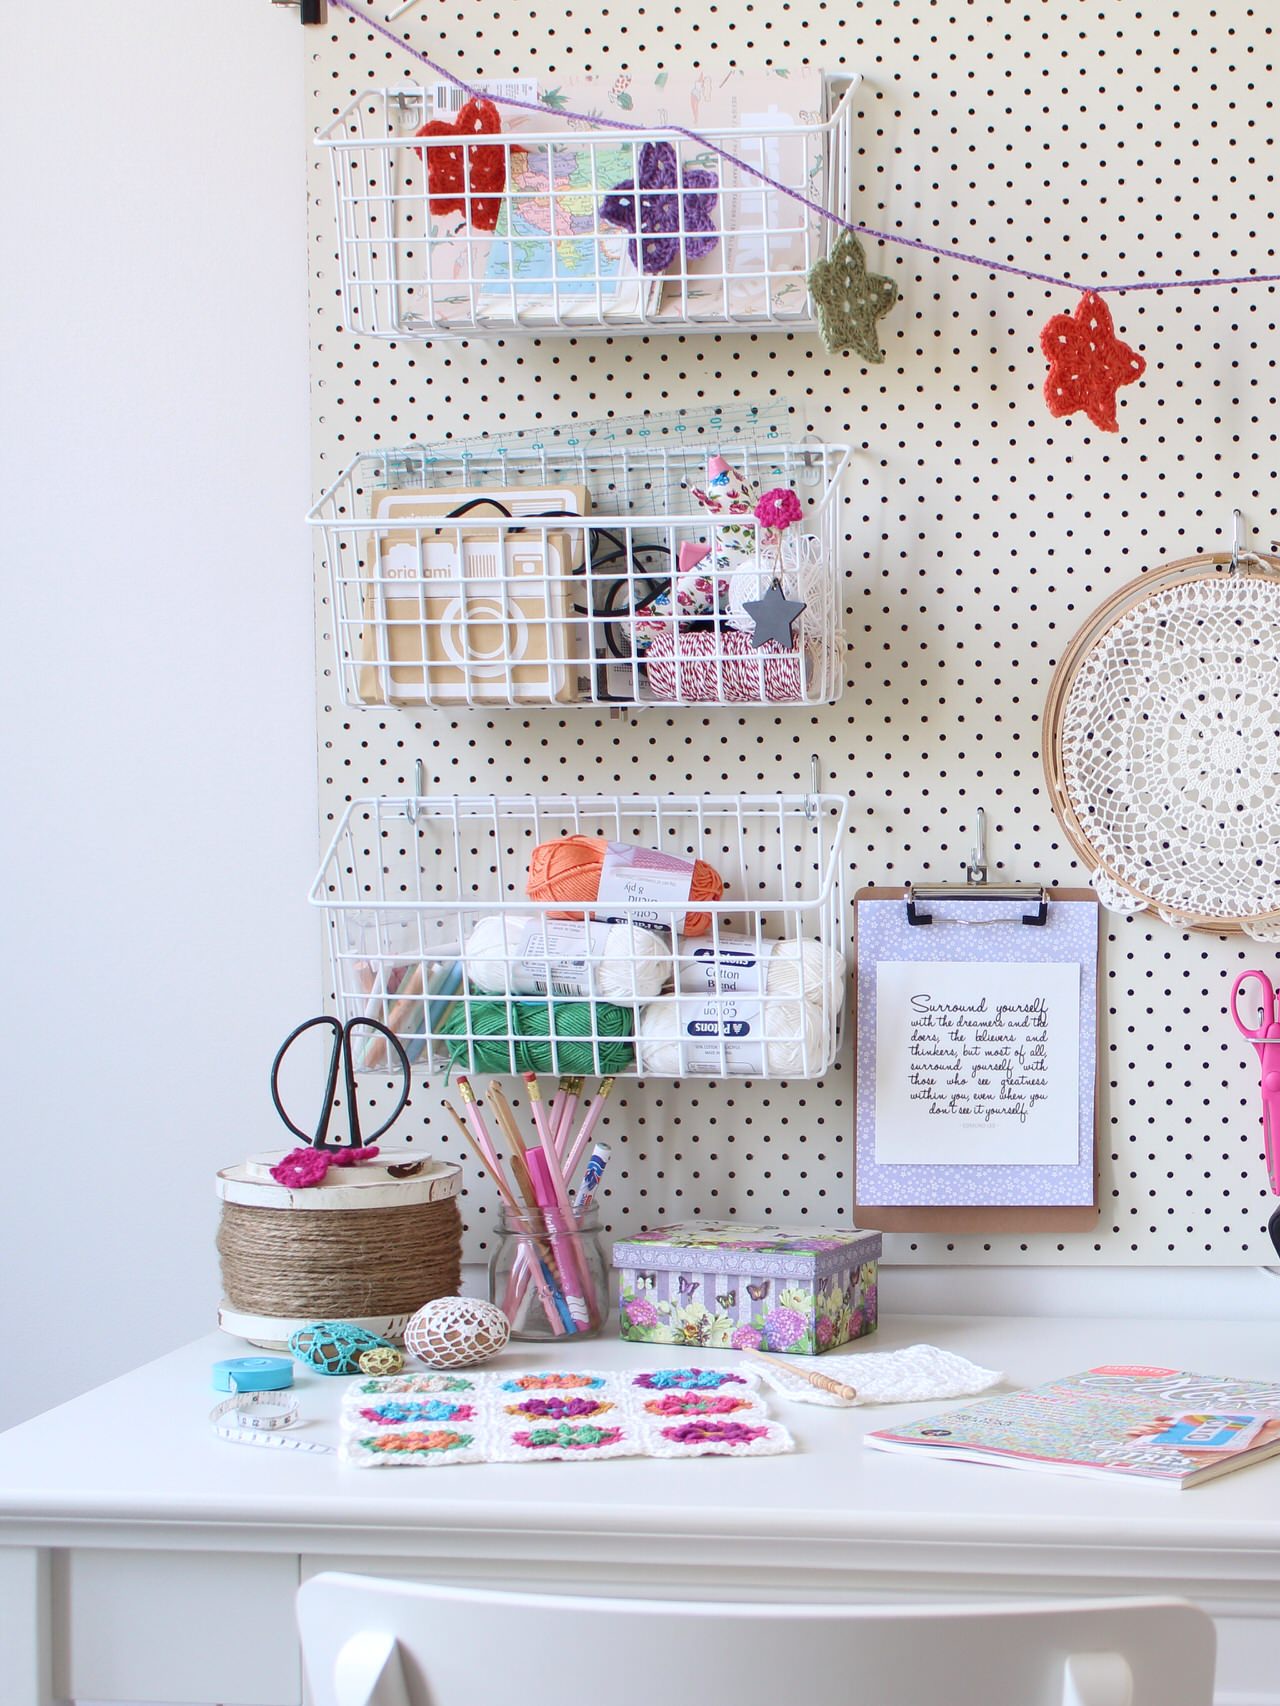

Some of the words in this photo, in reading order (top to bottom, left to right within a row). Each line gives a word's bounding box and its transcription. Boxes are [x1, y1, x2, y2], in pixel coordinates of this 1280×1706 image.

[703, 1008, 738, 1018] Coton
[910, 994, 988, 1013] Surround
[995, 997, 1048, 1024] yourself
[910, 1014, 936, 1027] with
[936, 1014, 954, 1027] the
[956, 1014, 1005, 1027] dreamers
[1008, 1015, 1031, 1027] and
[1030, 1015, 1048, 1027] the
[948, 1029, 966, 1042] the
[975, 1029, 1016, 1042] believers
[1025, 1029, 1048, 1042] and
[908, 1044, 959, 1058] thinkers,
[963, 1044, 981, 1056] but
[984, 1046, 1011, 1056] most
[1014, 1044, 1026, 1065] of
[910, 1058, 962, 1071] surround
[972, 1058, 1014, 1080] yourself
[1023, 1058, 1048, 1071] with
[908, 1073, 937, 1085] those
[946, 1073, 968, 1085] who
[977, 1078, 991, 1086] see
[1000, 1075, 1048, 1094] greatness
[909, 1087, 947, 1099] within
[999, 1088, 1026, 1100] when
[1029, 1093, 1048, 1107] you
[973, 1104, 985, 1114] it
